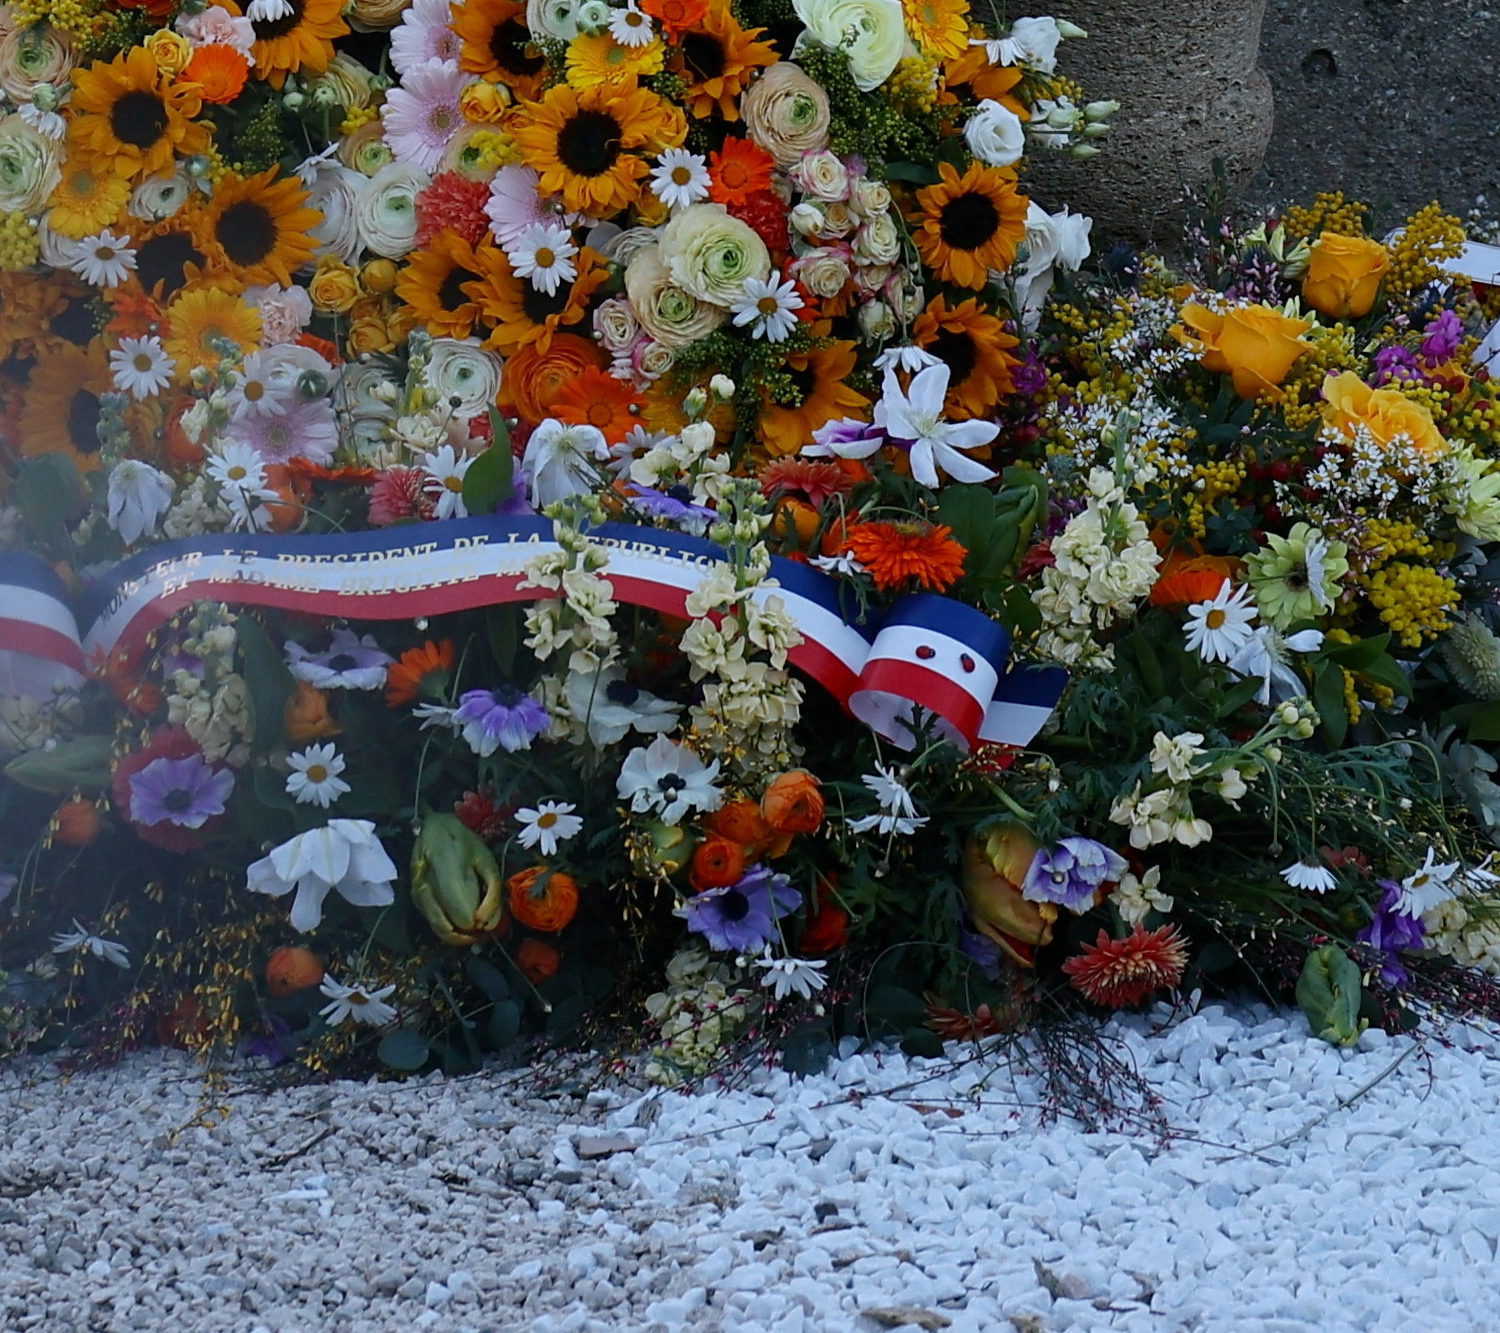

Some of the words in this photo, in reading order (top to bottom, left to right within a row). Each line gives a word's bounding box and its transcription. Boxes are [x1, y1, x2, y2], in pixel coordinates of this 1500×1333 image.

[223, 548, 258, 565] LE
[277, 541, 438, 567] PRESIDENT
[453, 534, 490, 552] DE
[507, 532, 542, 551] LA
[161, 576, 193, 600] ET
[208, 568, 321, 595] MADAME
[338, 563, 480, 597] BRIGITTE
